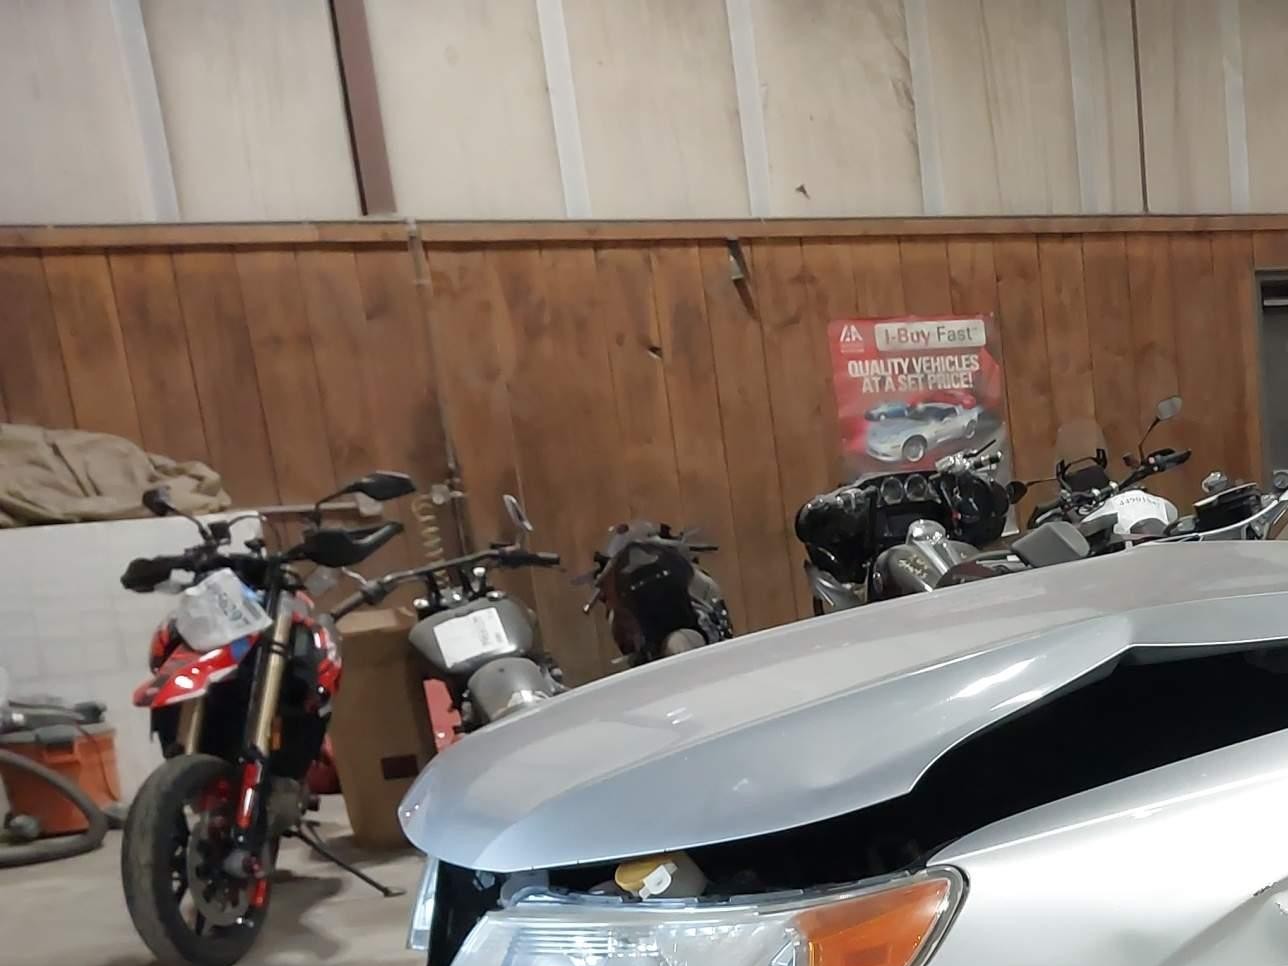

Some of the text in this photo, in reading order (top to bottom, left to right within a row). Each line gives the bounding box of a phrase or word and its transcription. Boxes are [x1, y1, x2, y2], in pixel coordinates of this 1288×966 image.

[885, 328, 930, 346] I-Buy
[848, 355, 980, 377] QUALITY VEHICLES
[862, 371, 974, 393] AT A SET PRICE!
